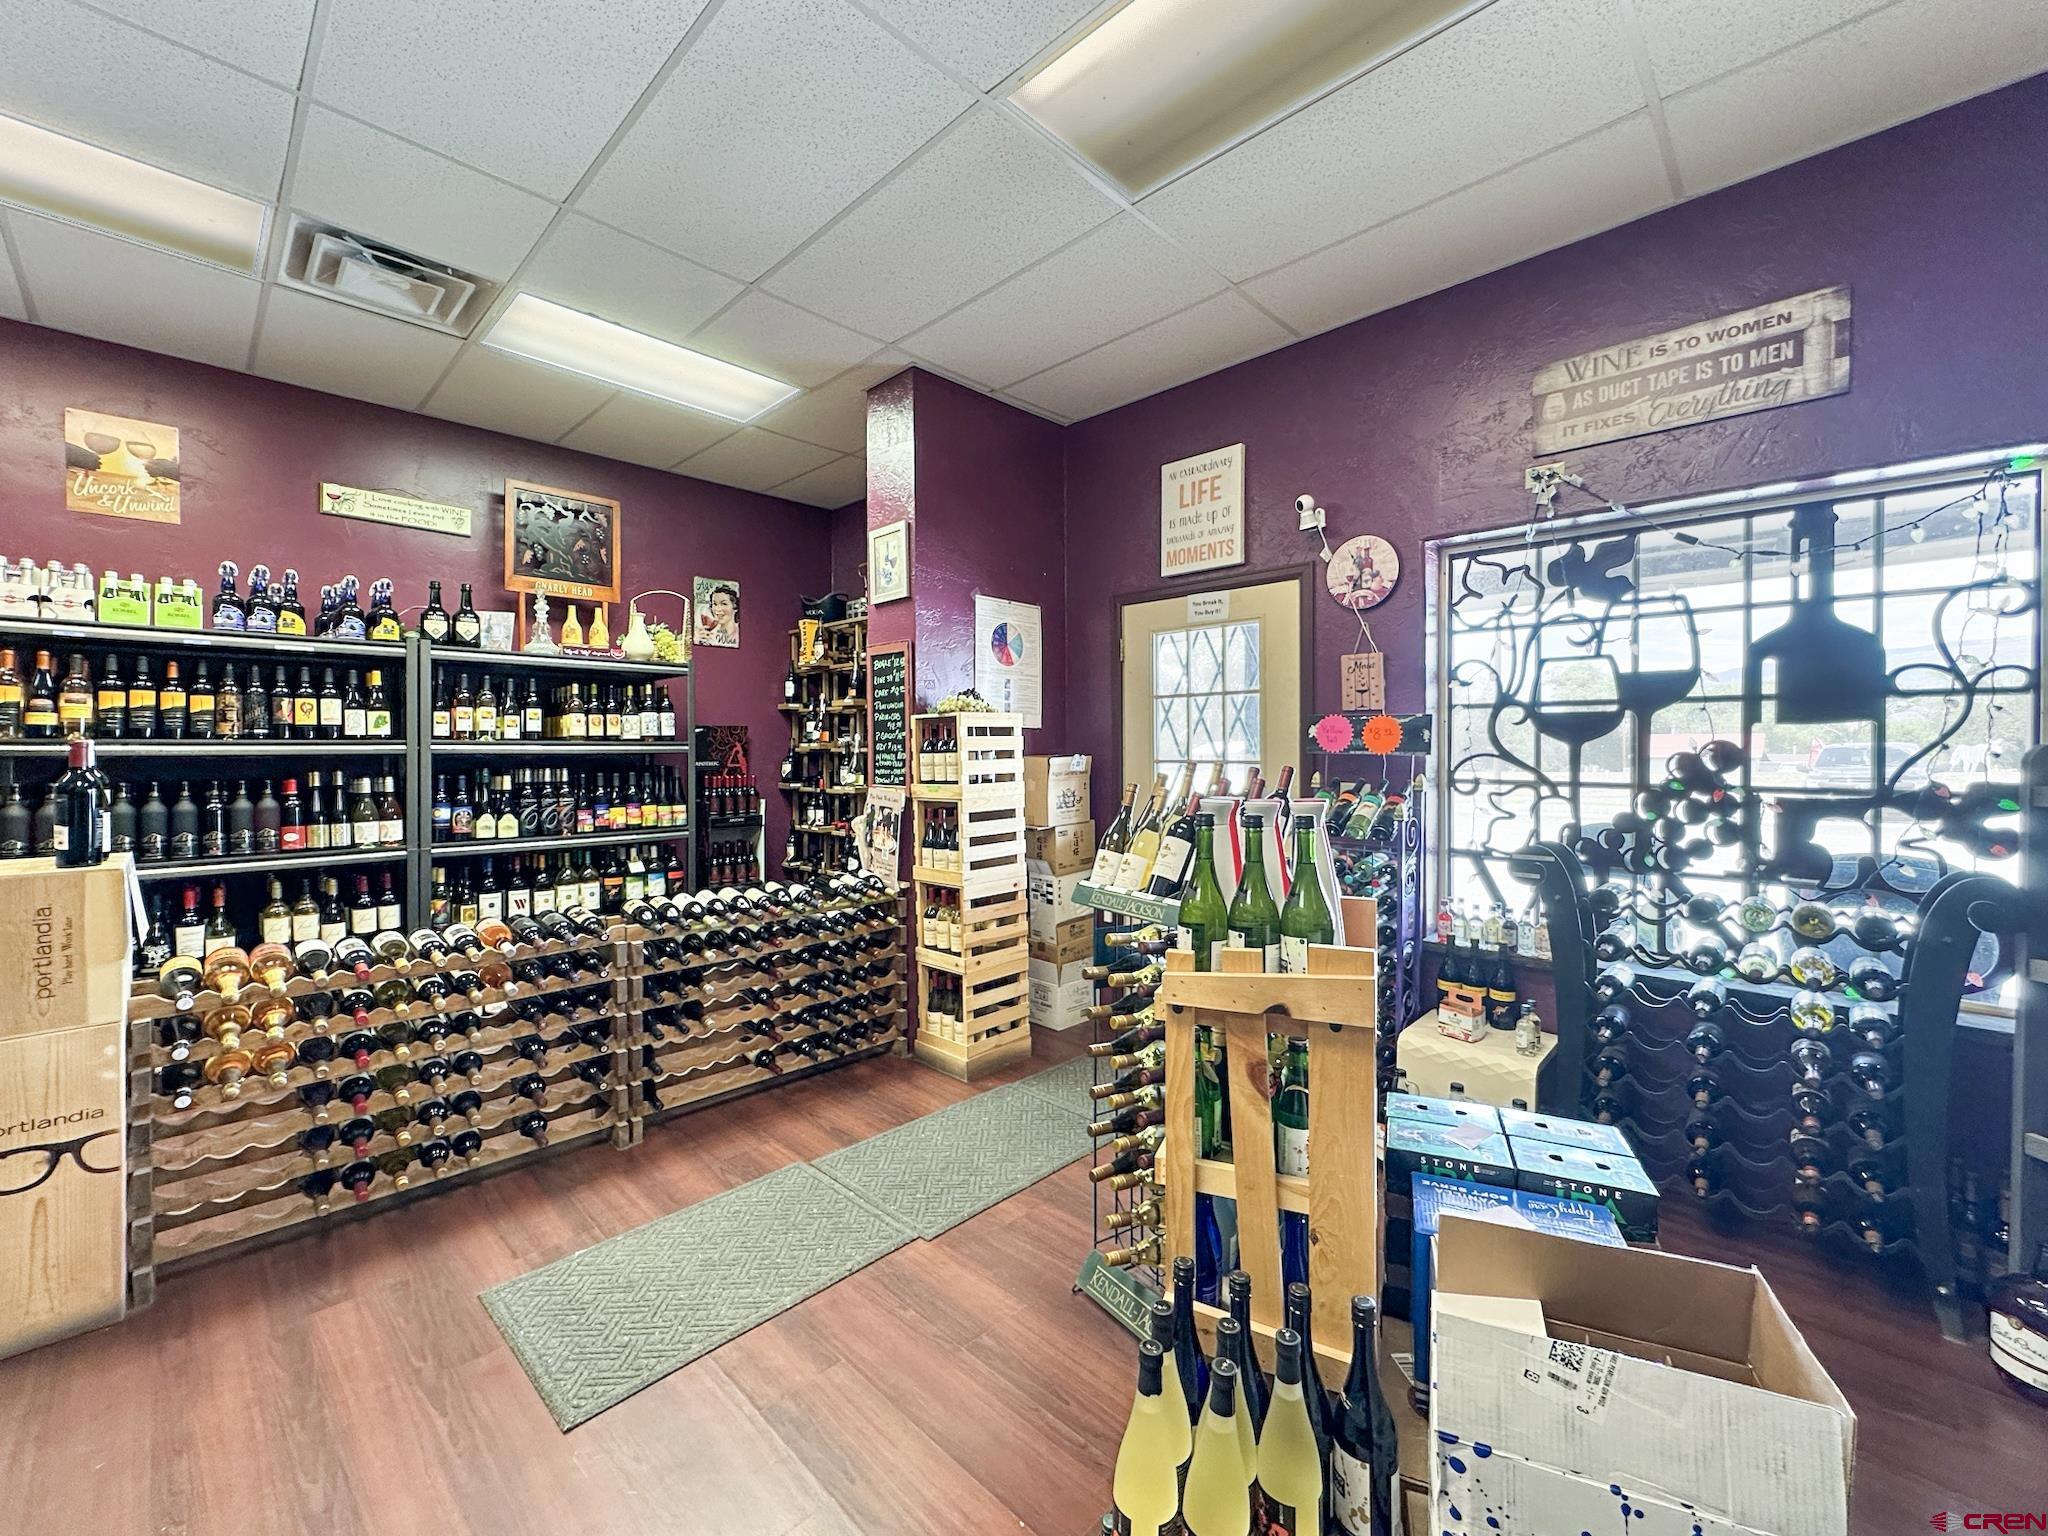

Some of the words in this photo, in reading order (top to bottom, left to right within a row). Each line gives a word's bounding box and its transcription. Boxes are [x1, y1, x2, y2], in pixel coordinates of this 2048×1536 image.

[1564, 346, 1641, 381] WINE
[1649, 344, 1668, 359] IS
[1674, 336, 1701, 352] TO
[1706, 311, 1793, 344] WOMEN
[1572, 391, 1592, 411] AS
[1600, 379, 1640, 402] DUCT
[1646, 366, 1689, 392] TAPE
[1695, 360, 1713, 380] IS
[1719, 353, 1743, 376] TO
[1749, 340, 1794, 369] MEN
[1563, 423, 1577, 438] IT
[1583, 412, 1636, 434] FIXES
[1648, 378, 1791, 427] Everything
[73, 474, 137, 497] Uncork
[1179, 475, 1222, 509] LIFE
[97, 495, 113, 507] &
[112, 495, 176, 514] Unwind
[441, 505, 467, 518] WINE
[1166, 539, 1234, 568] MOMENTS
[535, 581, 568, 594] GNARLY
[571, 585, 593, 597] HEAD
[1090, 893, 1166, 919] KENDALL-JACKSON
[32, 906, 56, 1000] portlandia
[1420, 1156, 1481, 1174] STONE
[1421, 1179, 1467, 1193] SERVE
[1471, 1190, 1509, 1202] SOFT
[1555, 1179, 1623, 1201] STONE
